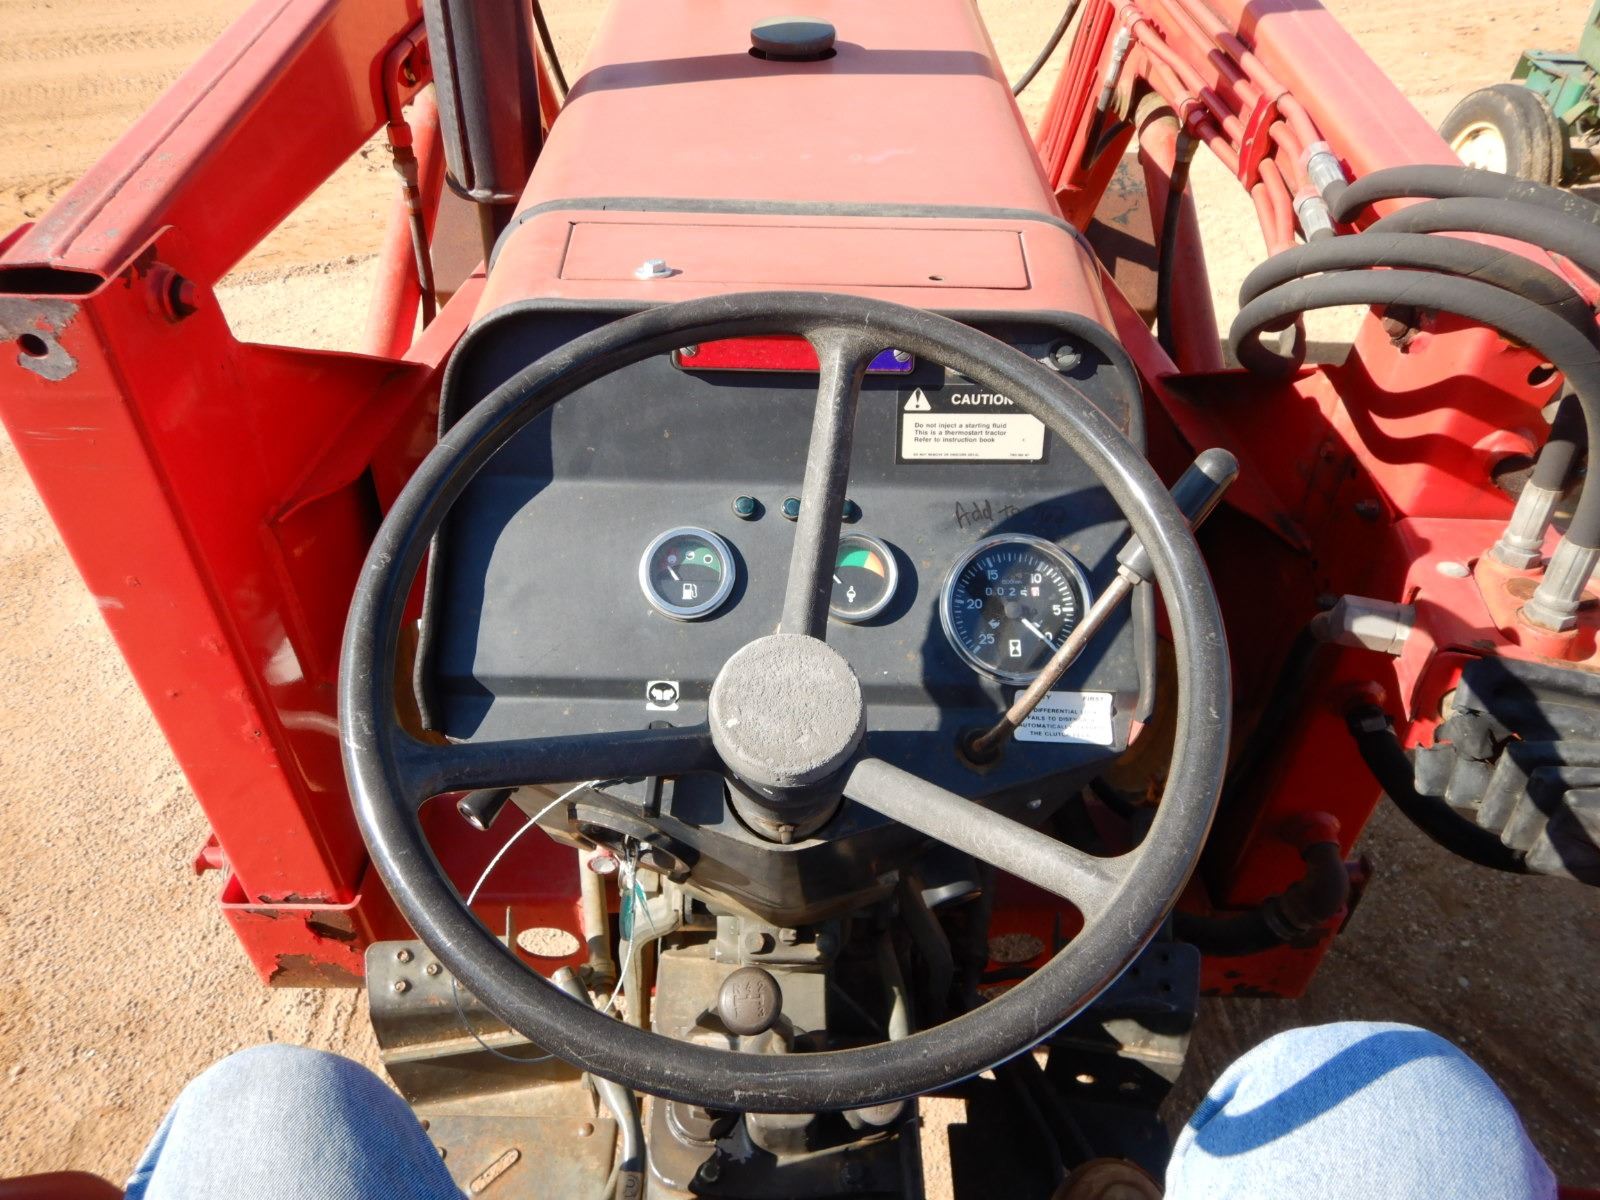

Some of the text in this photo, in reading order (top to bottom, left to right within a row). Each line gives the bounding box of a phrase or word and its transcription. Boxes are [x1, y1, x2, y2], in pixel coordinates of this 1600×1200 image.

[951, 393, 1014, 406] CAUTION
[938, 422, 957, 430] inject
[965, 422, 991, 430] starting
[955, 500, 993, 528] Add
[987, 569, 999, 580] 15
[1031, 573, 1042, 584] 10
[966, 599, 983, 609] 20
[1052, 604, 1061, 616] 5
[978, 633, 995, 645] 25
